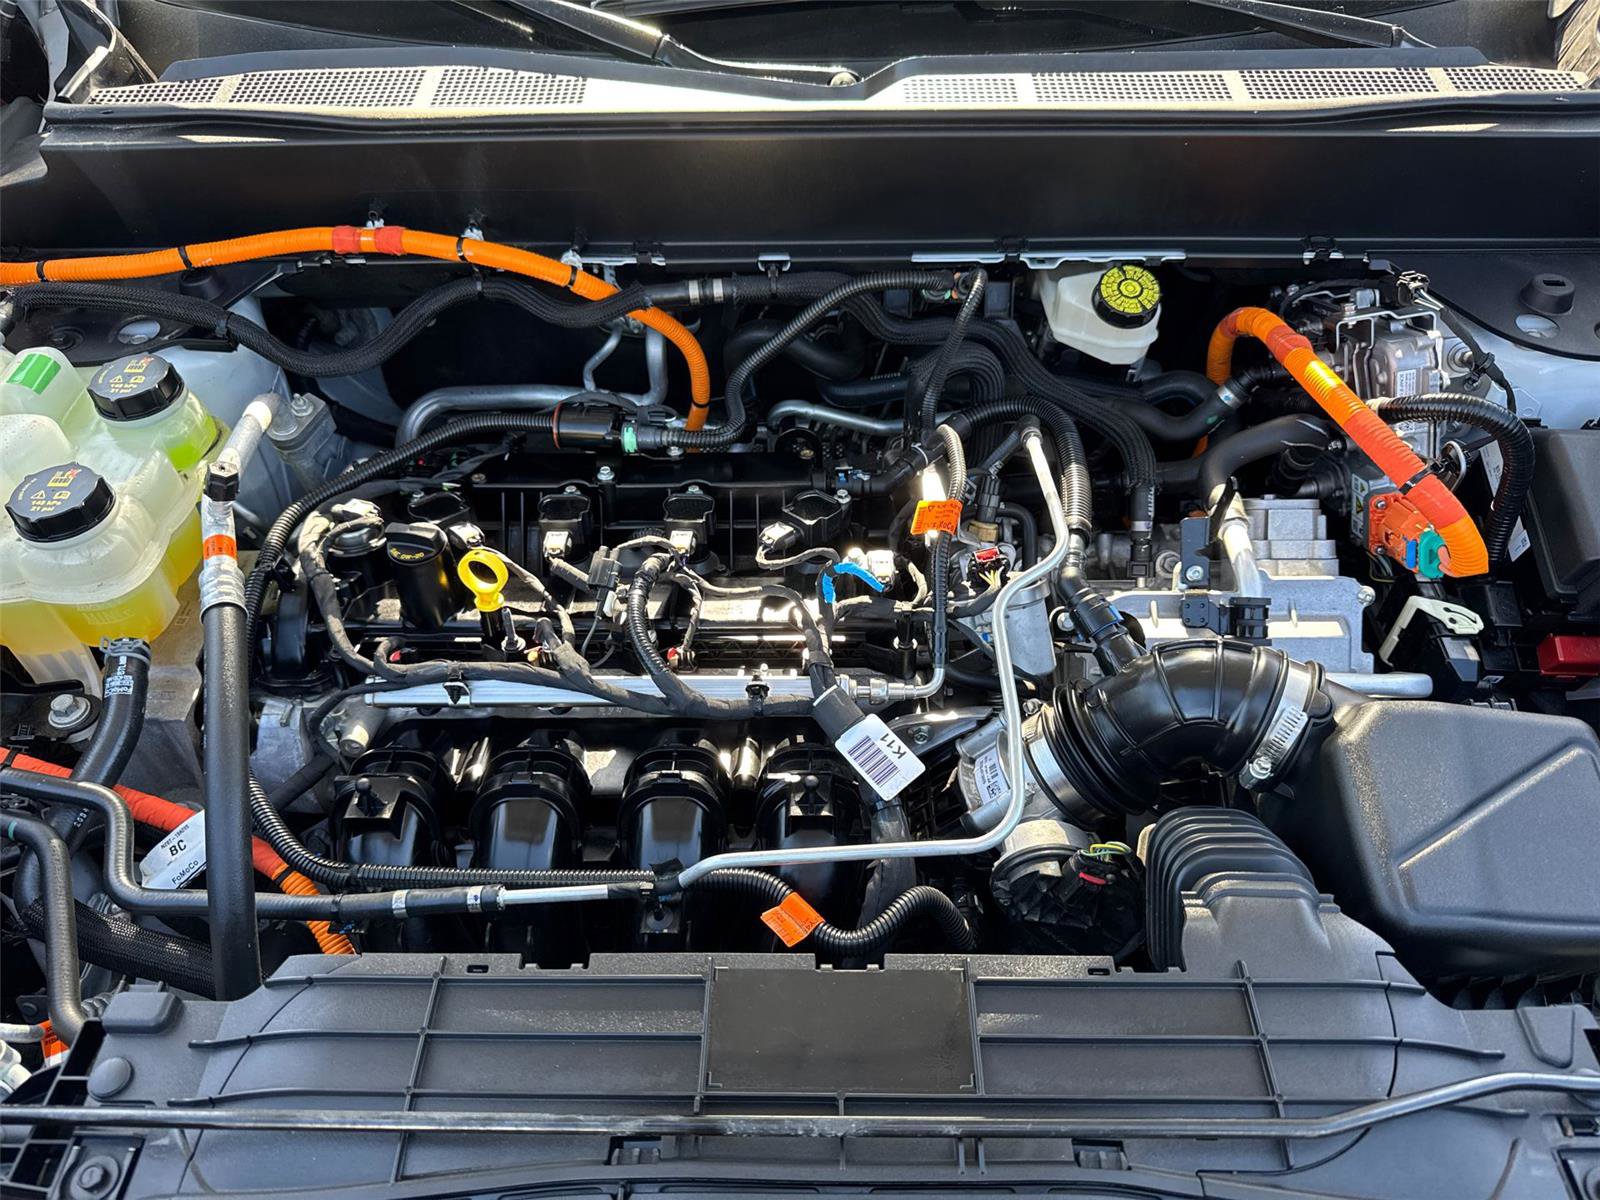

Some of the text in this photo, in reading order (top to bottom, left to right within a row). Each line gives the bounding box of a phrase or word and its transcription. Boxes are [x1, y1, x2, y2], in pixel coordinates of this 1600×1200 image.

[880, 732, 907, 759] K11
[169, 839, 187, 856] BC
[171, 860, 199, 885] FoMoCo
